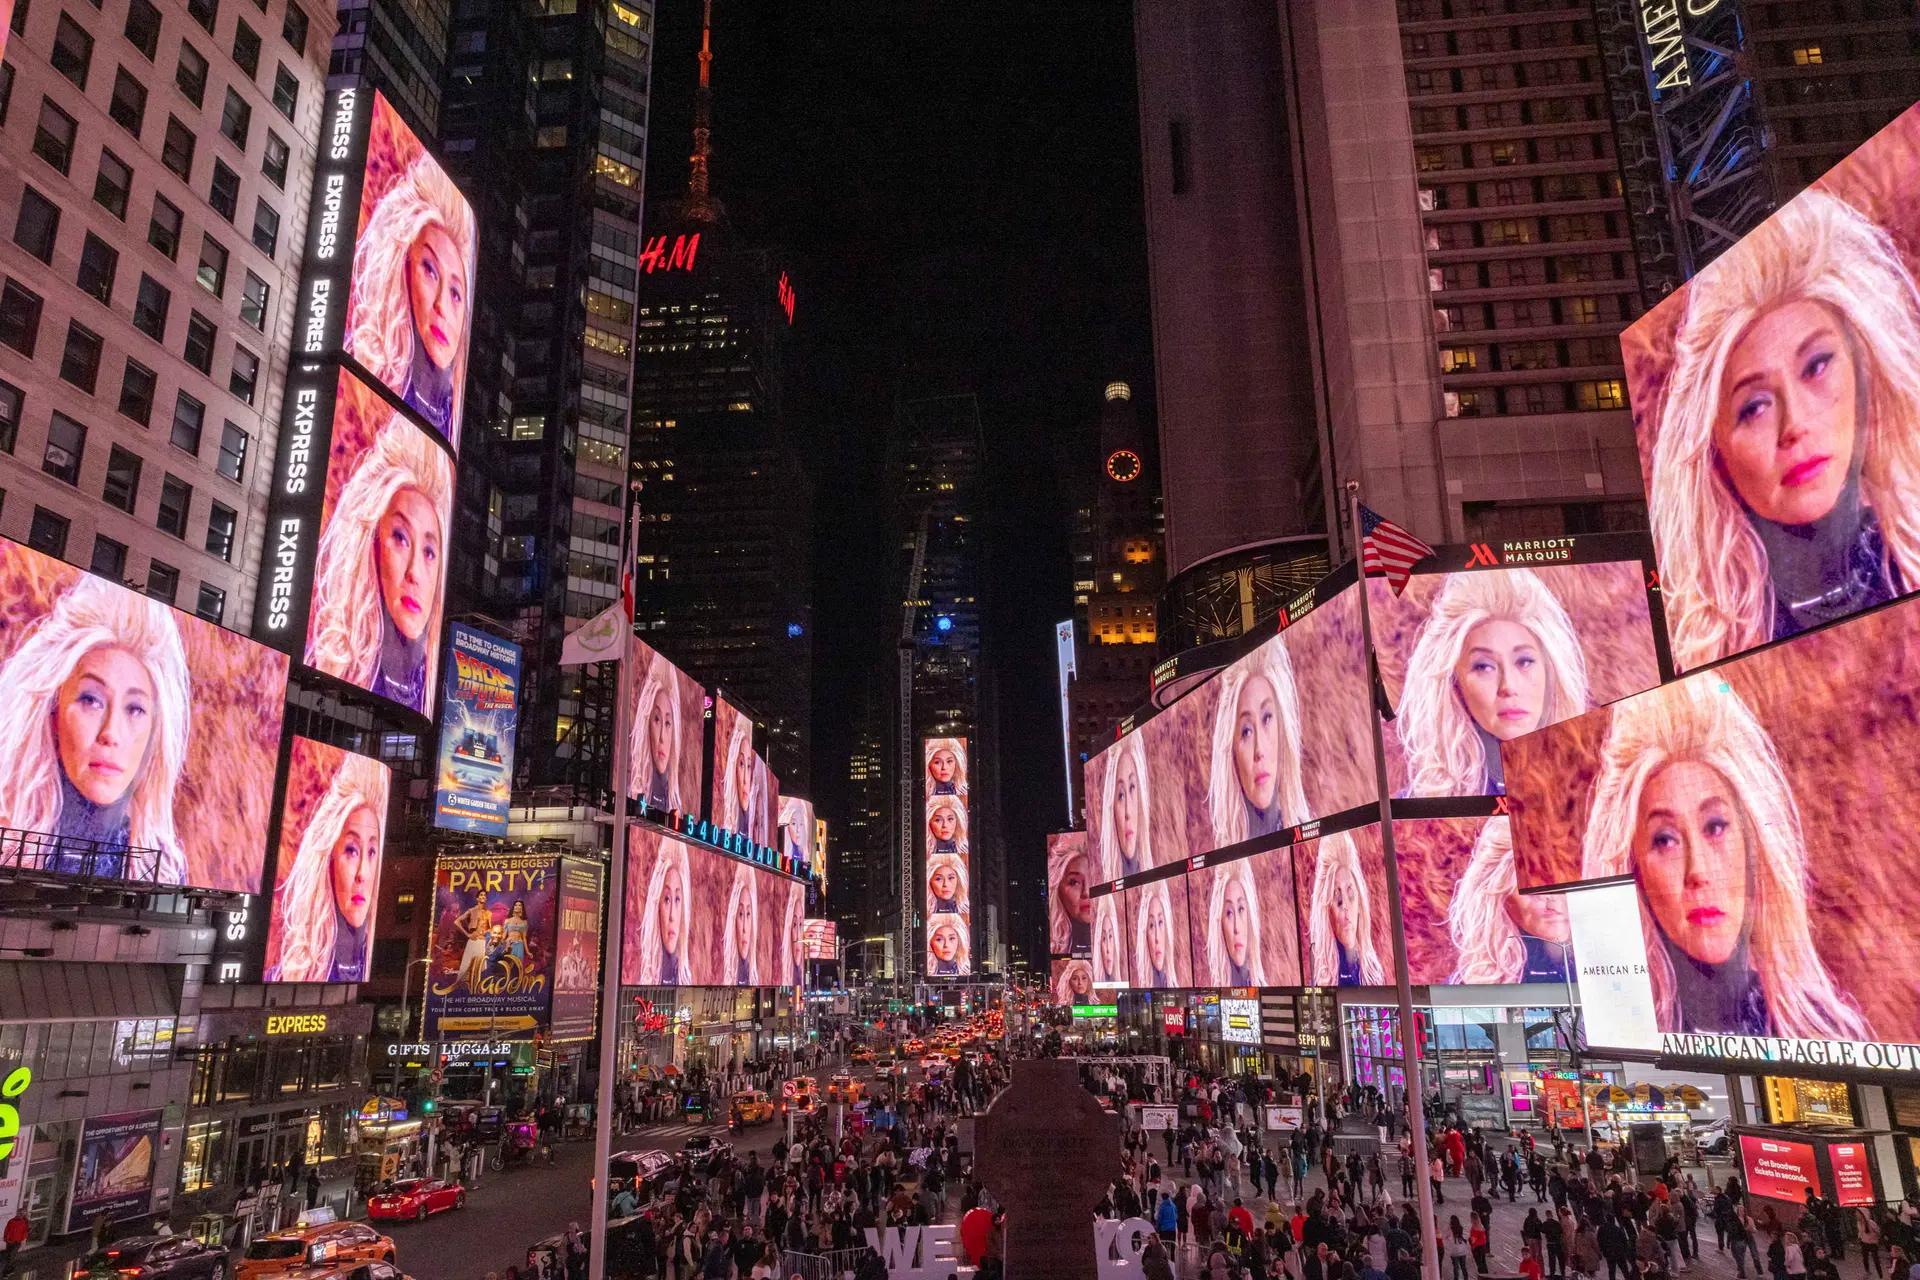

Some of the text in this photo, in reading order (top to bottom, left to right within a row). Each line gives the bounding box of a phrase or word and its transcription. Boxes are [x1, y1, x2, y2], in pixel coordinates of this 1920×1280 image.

[317, 174, 344, 259] EXPRESS
[639, 233, 700, 274] H&M
[285, 389, 316, 494] EXPRESS
[1503, 538, 1576, 551] MARRIOTT
[1505, 550, 1569, 562] MARQUIS
[268, 518, 300, 629] EXPRESS
[673, 809, 800, 875] 1540 BROADWAY
[440, 858, 555, 871] BROADWAY'S BIGGEST
[449, 869, 546, 893] PARTY!
[432, 953, 546, 995] Aladdin
[1583, 964, 1629, 976] AMERICAN
[507, 995, 537, 1003] MUSICAL
[266, 1014, 327, 1035] EXPRESS
[387, 1043, 512, 1056] GIFTS LUGGAGE
[1298, 1034, 1331, 1048] SEPHRA
[1662, 1033, 1771, 1061] AMERICAN
[1777, 1038, 1857, 1067] EAGLE
[1754, 1166, 1774, 1177] tickets
[1758, 1158, 1801, 1173] Get Broadway
[863, 1225, 957, 1270] WE
